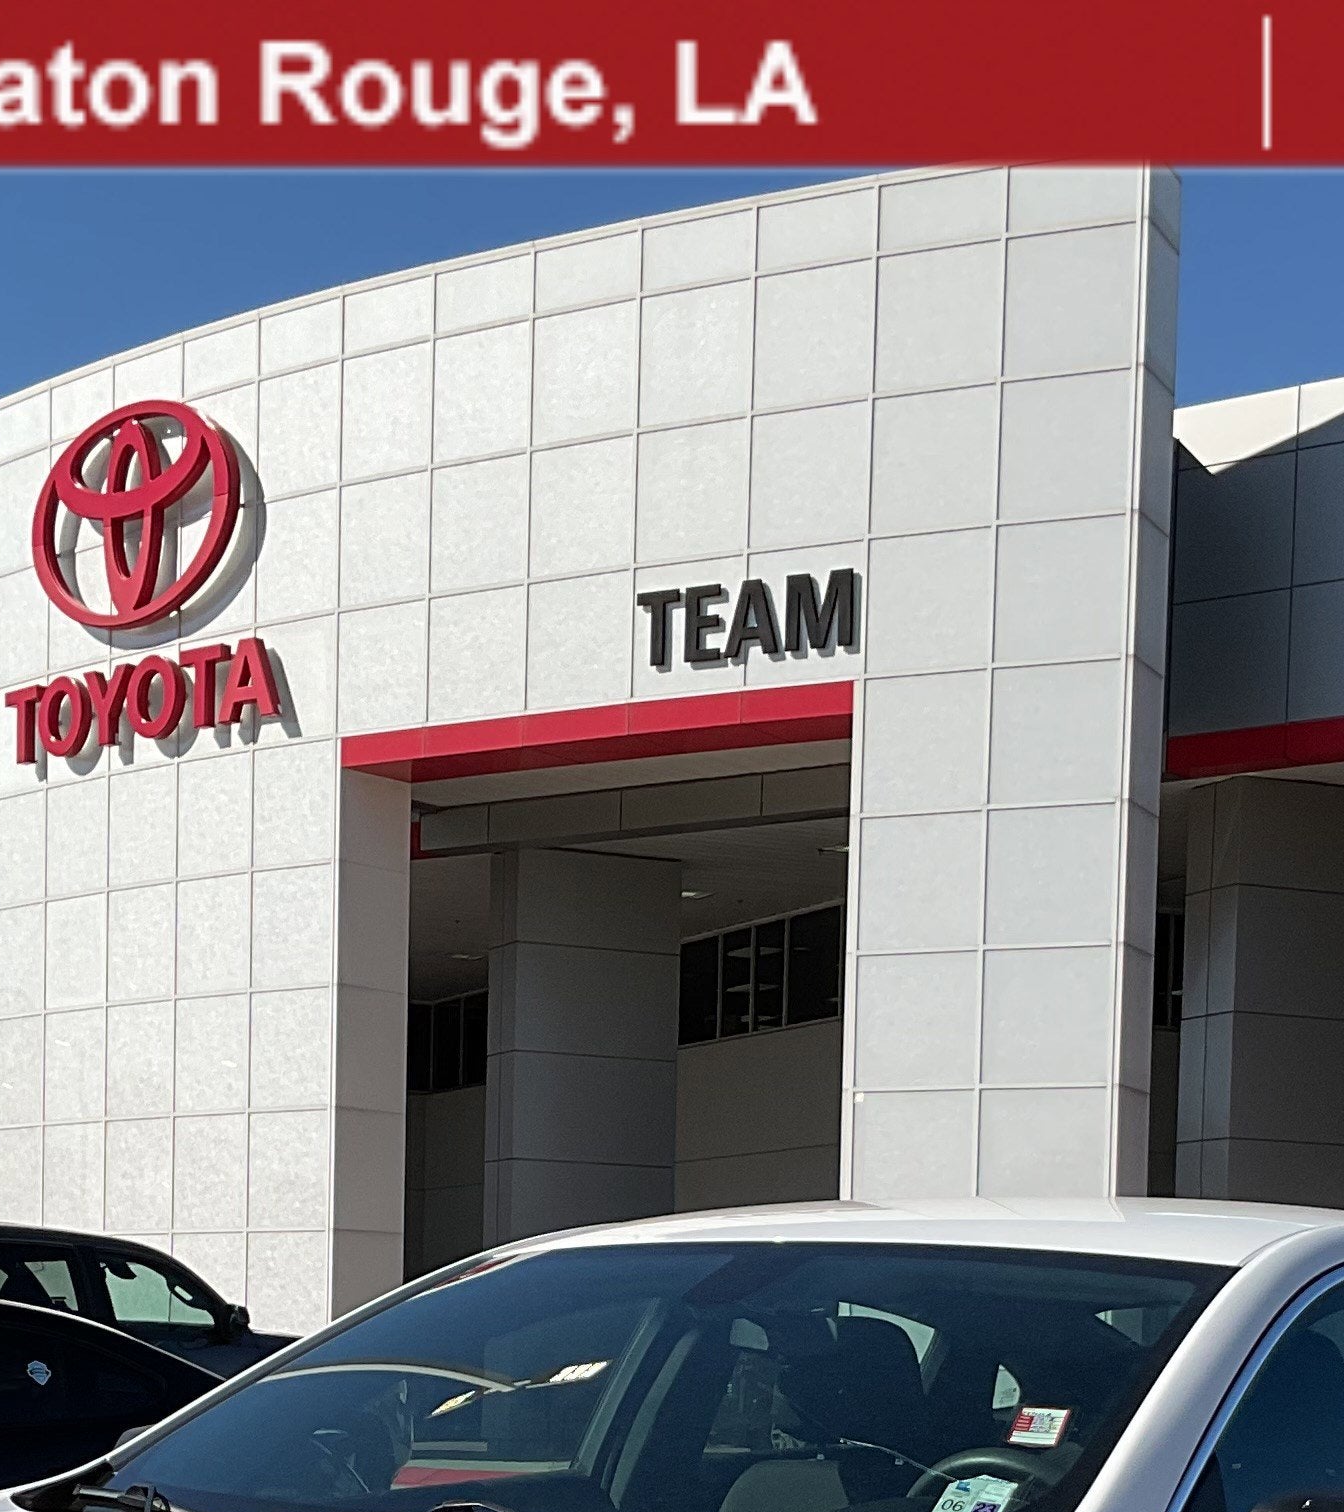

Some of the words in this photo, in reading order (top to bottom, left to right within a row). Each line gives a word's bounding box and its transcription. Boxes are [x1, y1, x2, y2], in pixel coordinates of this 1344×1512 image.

[636, 567, 858, 667] TEAM
[4, 636, 283, 766] TOYOTA
[941, 1498, 966, 1512] 06
